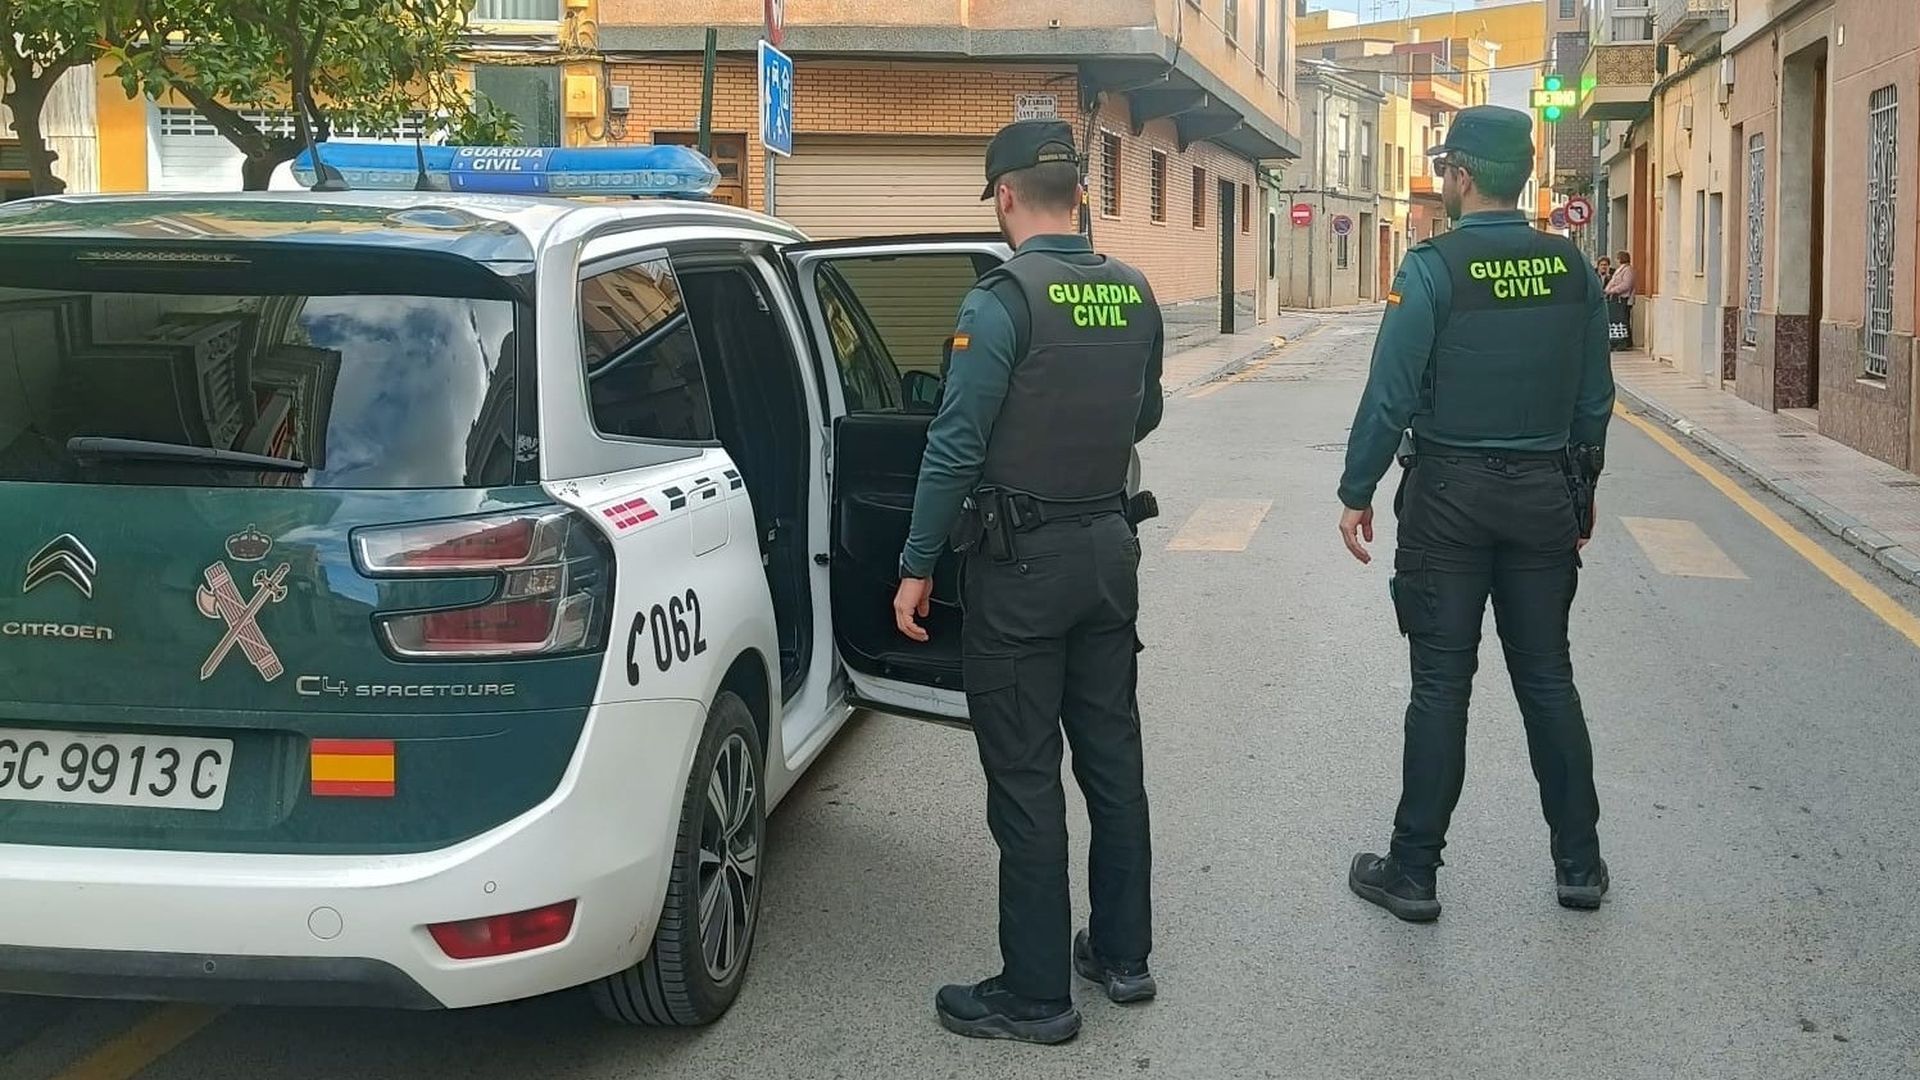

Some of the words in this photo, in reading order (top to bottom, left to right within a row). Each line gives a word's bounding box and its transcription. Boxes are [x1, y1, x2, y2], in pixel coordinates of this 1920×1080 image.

[460, 147, 543, 158] GUARDIA
[472, 158, 521, 171] CIVIL
[1470, 256, 1568, 279] GUARDIA
[1048, 283, 1142, 304] GUARDIA
[1493, 276, 1551, 299] CIVIL
[1073, 304, 1127, 327] CIVIL
[650, 587, 707, 672] 062
[295, 675, 348, 697] C4
[57, 743, 181, 797] 9913
[190, 749, 222, 799] C
